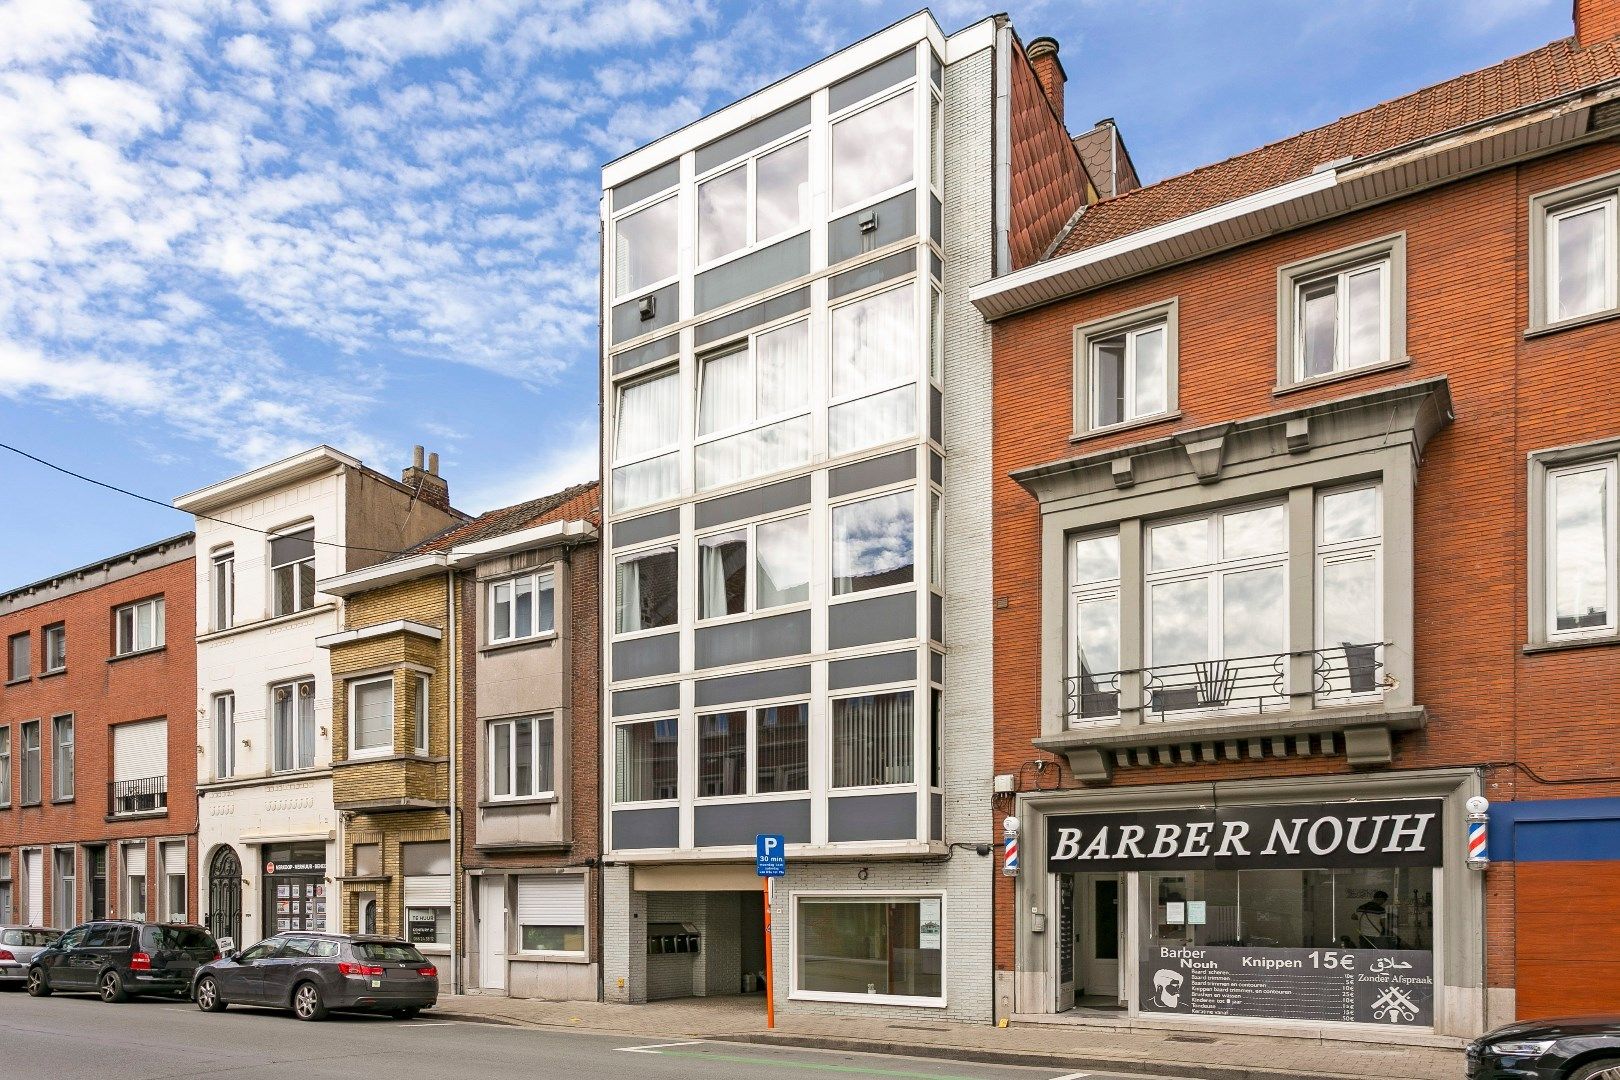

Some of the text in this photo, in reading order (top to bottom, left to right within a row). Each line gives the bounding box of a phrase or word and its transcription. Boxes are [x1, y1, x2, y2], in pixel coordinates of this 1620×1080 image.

[1050, 812, 1436, 860] BARBER NOUH
[765, 838, 777, 855] P
[1160, 947, 1206, 958] Barber
[1180, 959, 1218, 969] Nouh
[1242, 951, 1355, 970] Knippen 15€
[1358, 974, 1433, 985] Zonder Afspraak
